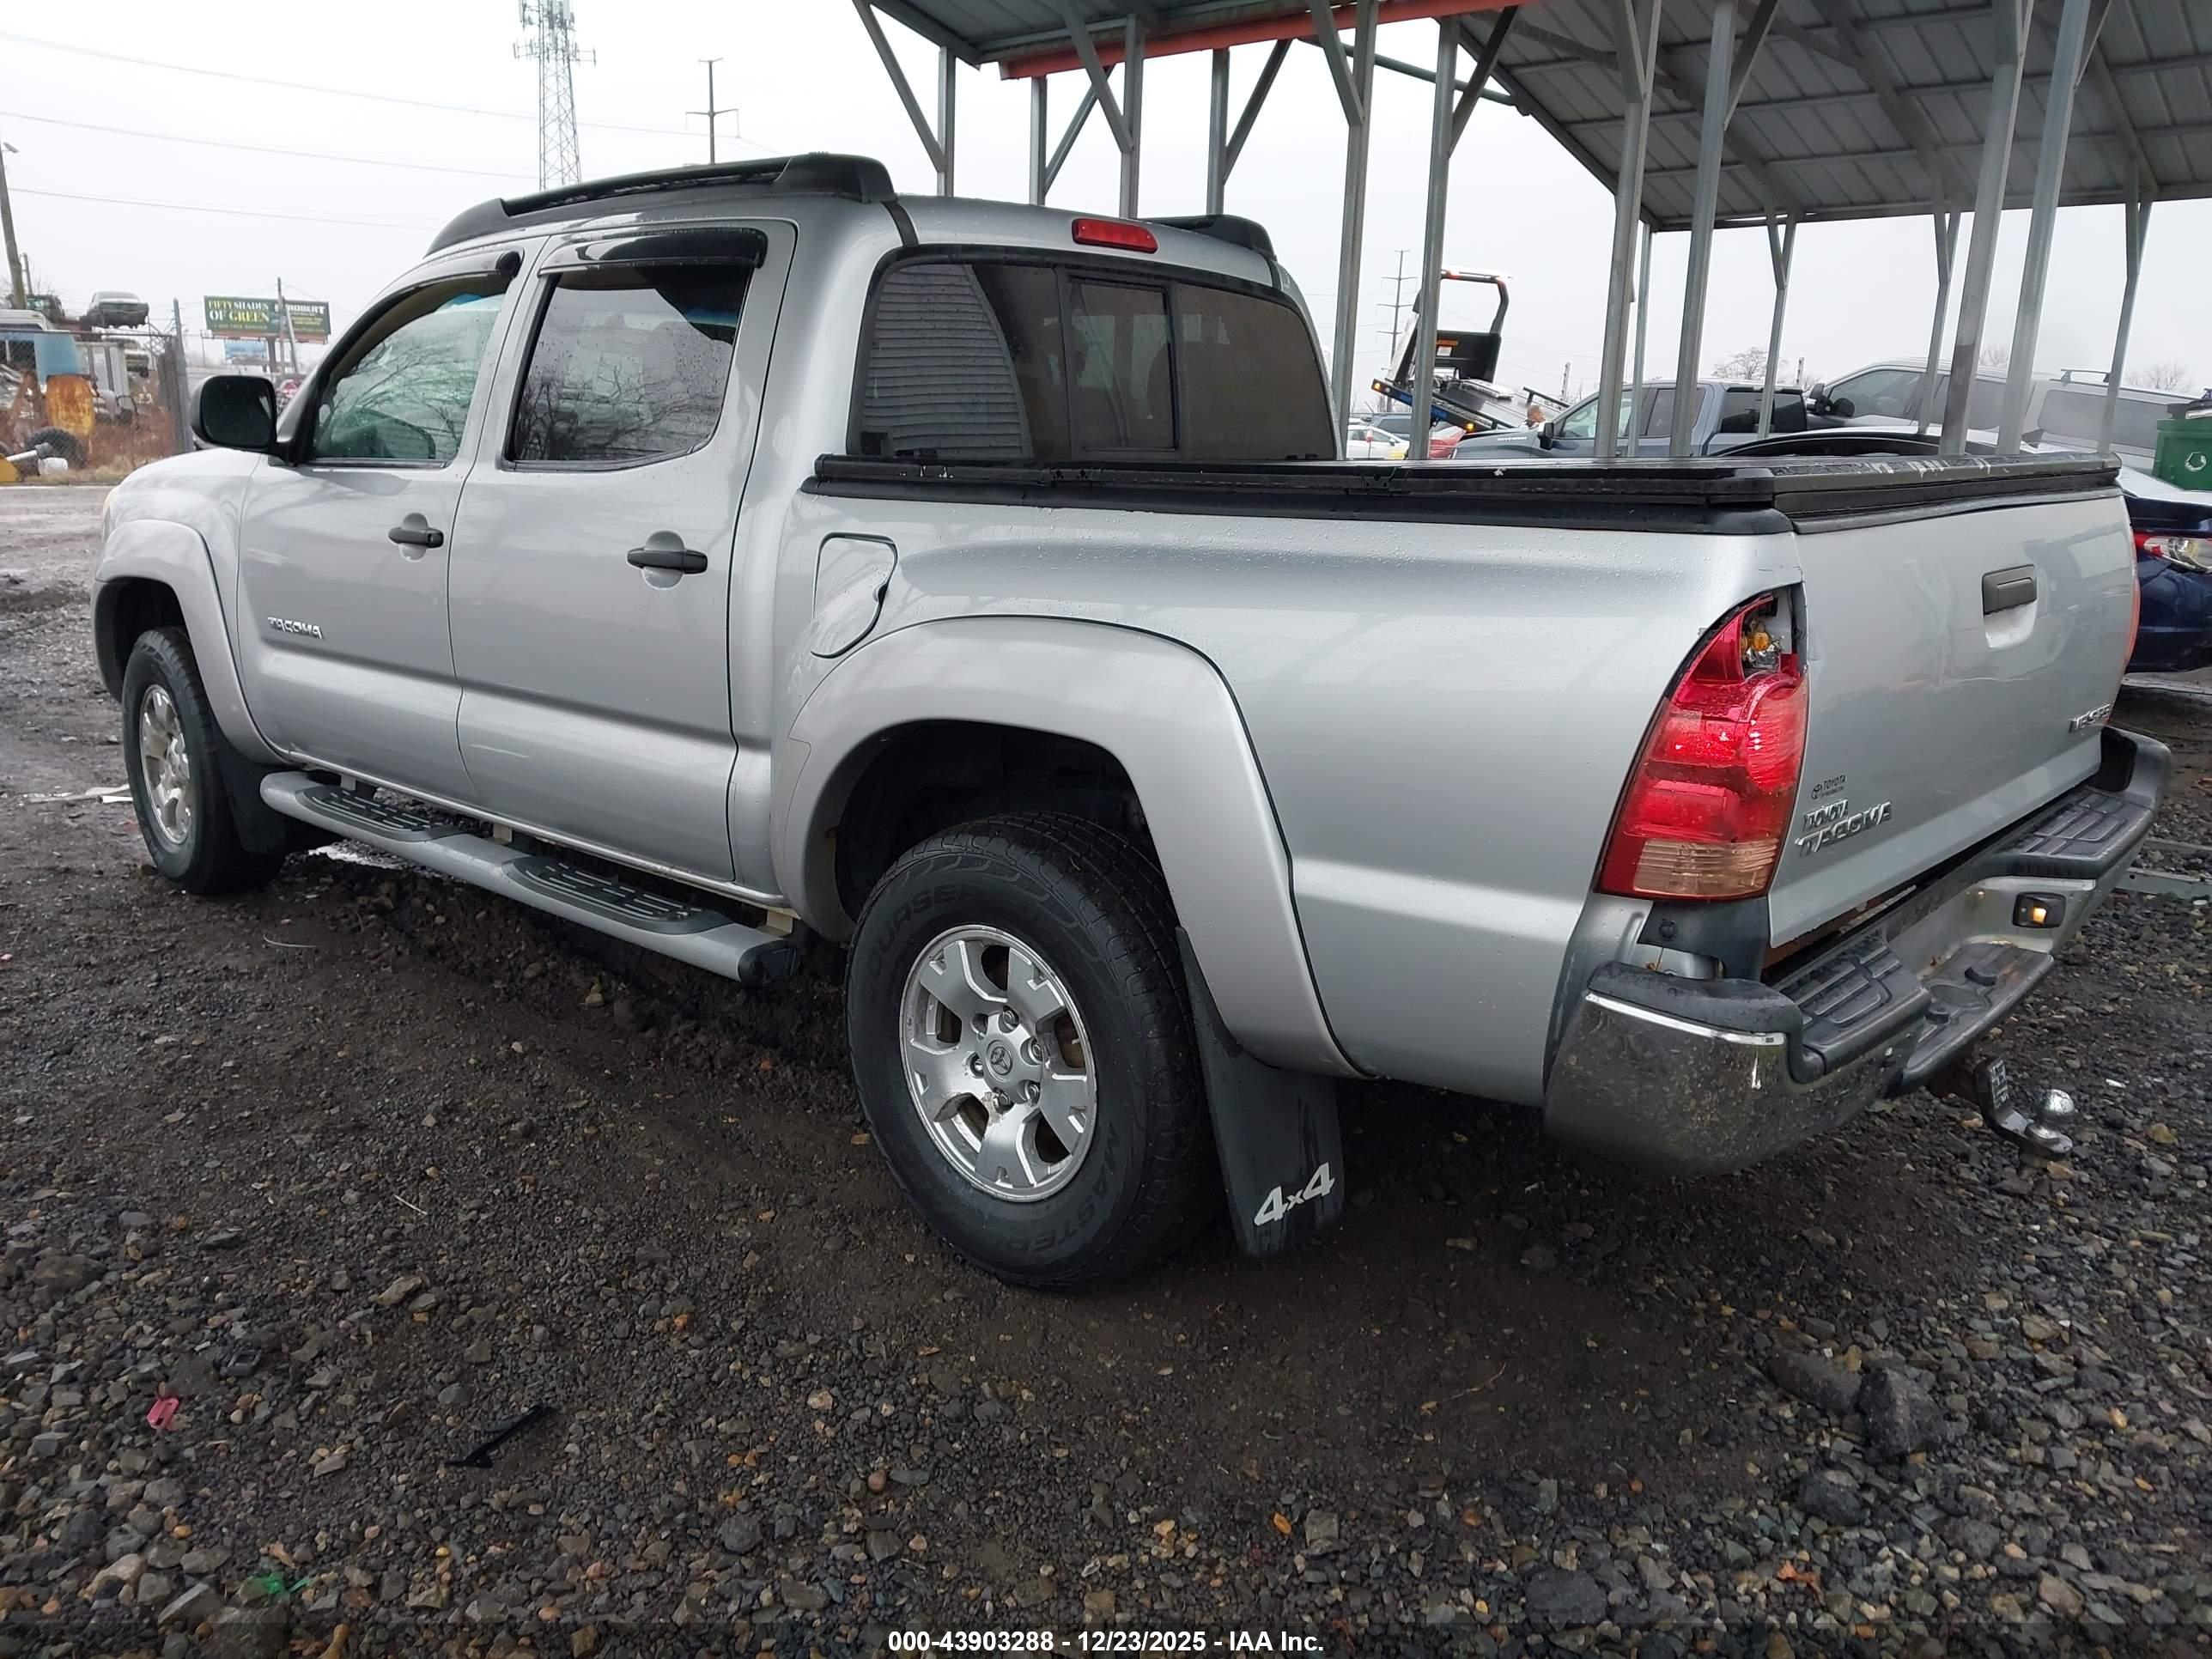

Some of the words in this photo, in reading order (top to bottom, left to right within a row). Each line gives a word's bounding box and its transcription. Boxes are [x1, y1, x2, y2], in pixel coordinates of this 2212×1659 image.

[209, 300, 232, 309] FIFTY
[233, 301, 269, 311] SHADES
[209, 309, 227, 321] OF
[228, 311, 270, 324] GREEN
[267, 616, 323, 640] TACOMA
[1823, 774, 1846, 790] TOYOTA
[1795, 800, 1892, 857] TACOMA
